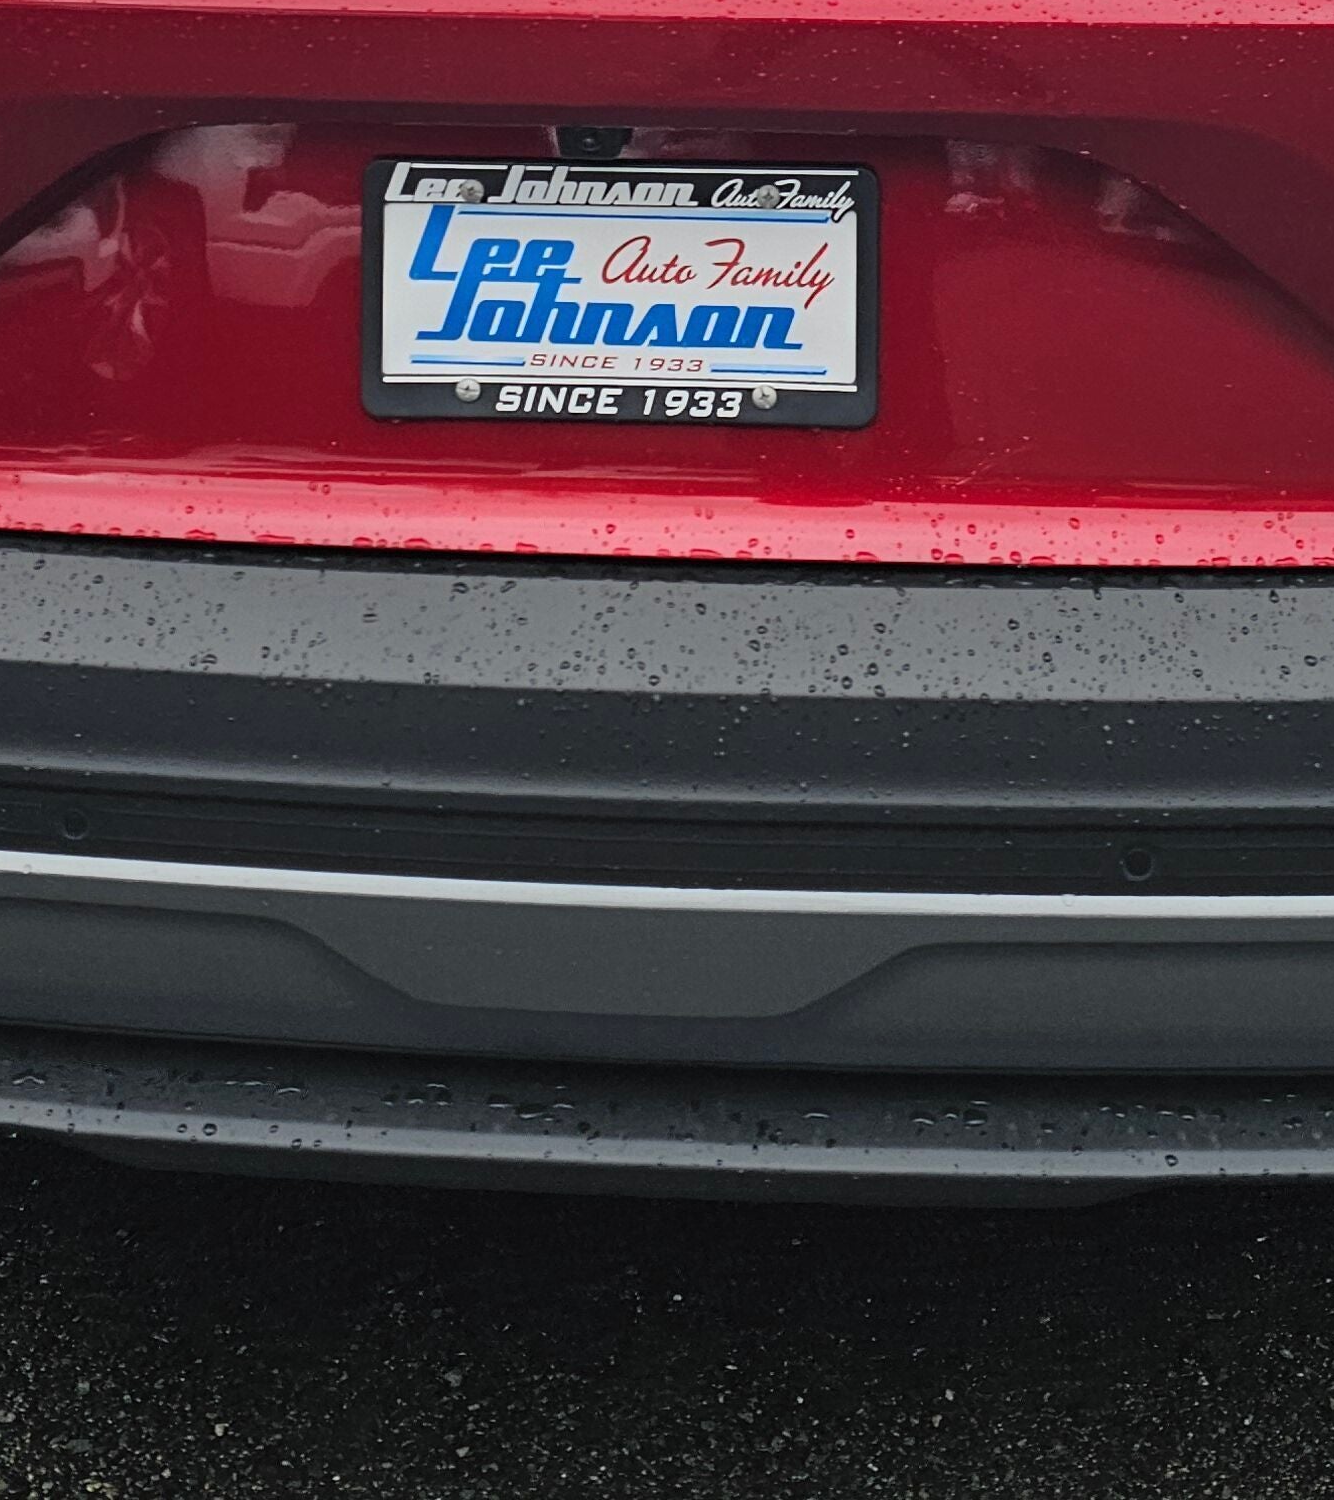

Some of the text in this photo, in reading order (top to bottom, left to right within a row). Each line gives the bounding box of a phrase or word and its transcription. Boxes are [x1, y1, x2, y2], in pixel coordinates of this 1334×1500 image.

[384, 162, 856, 221] Lee Johnson Aut Family
[409, 205, 582, 283] Lee
[601, 235, 835, 310] Auto Family
[415, 278, 803, 350] Johnson
[530, 353, 704, 373] SINCE 1933
[495, 385, 744, 418] SINCE 1933
